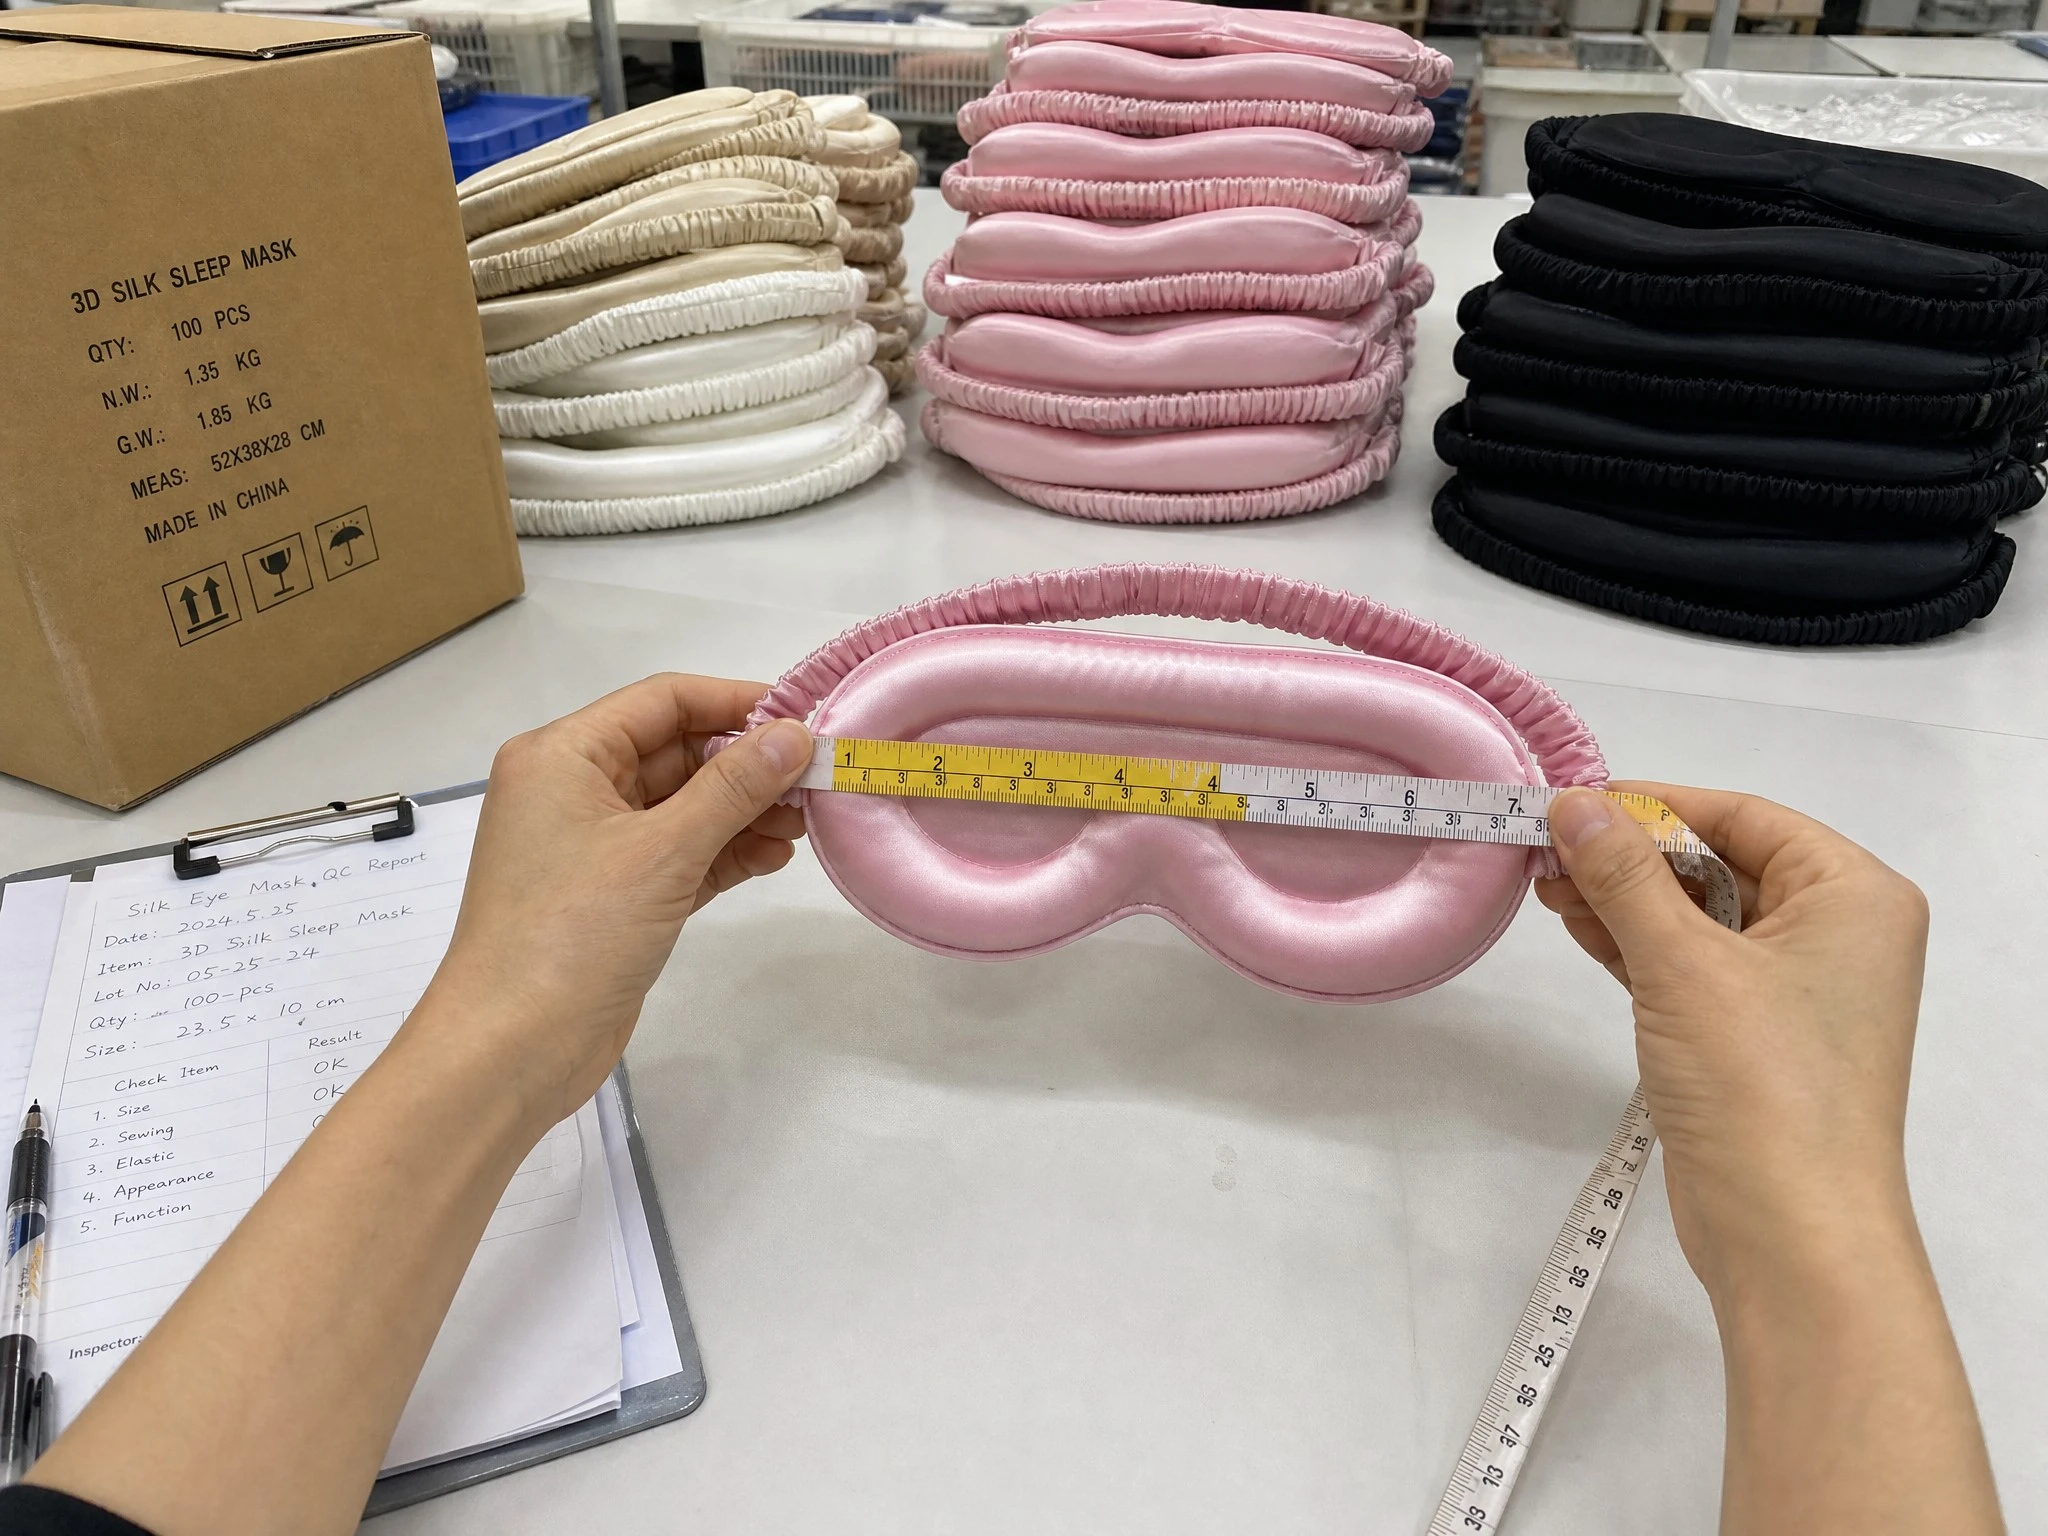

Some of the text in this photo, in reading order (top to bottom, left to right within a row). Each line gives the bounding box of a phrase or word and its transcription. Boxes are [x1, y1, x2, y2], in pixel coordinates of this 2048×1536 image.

[71, 238, 297, 314] 3D SILK SLEEP MASK
[87, 304, 251, 364] QTY: 100 PCS
[101, 349, 262, 411] N.W.: 1.35 KG
[116, 392, 272, 455] G.W.: 1.85 KG
[130, 419, 326, 500] MEAS: 52X38X28 CM
[144, 477, 290, 545] MADE IN CHINA
[844, 751, 852, 768] 1
[932, 755, 944, 772] 2
[1023, 761, 1034, 778] 3
[1114, 768, 1126, 784] 4
[1207, 775, 1219, 792] 4
[1304, 781, 1316, 799] 5
[1404, 789, 1416, 807] 6
[128, 898, 171, 918] Silk
[191, 889, 229, 909] Eye
[322, 866, 353, 883] QC
[368, 851, 428, 873] Report
[96, 905, 414, 977] Item: 3D Silk Sleep Mask
[103, 929, 158, 949] Date:
[93, 987, 125, 1003] Lot
[136, 979, 172, 994] No:
[84, 1040, 137, 1060] Size:
[176, 1014, 237, 1040] 23.5
[279, 1002, 303, 1018] 10
[315, 996, 346, 1010] cm
[89, 1012, 139, 1031] Qty:
[308, 1029, 363, 1050] Result
[113, 1061, 220, 1094] Check Item
[313, 1057, 349, 1075] OK
[312, 1083, 346, 1102] OK
[93, 1100, 152, 1123] 1. Size
[88, 1123, 175, 1150] 2. Sewing
[86, 1149, 175, 1176] 3. Elastic
[82, 1167, 216, 1204] 4. Appearance
[79, 1200, 192, 1234] 5. Function
[68, 1333, 143, 1361] Inspector:
